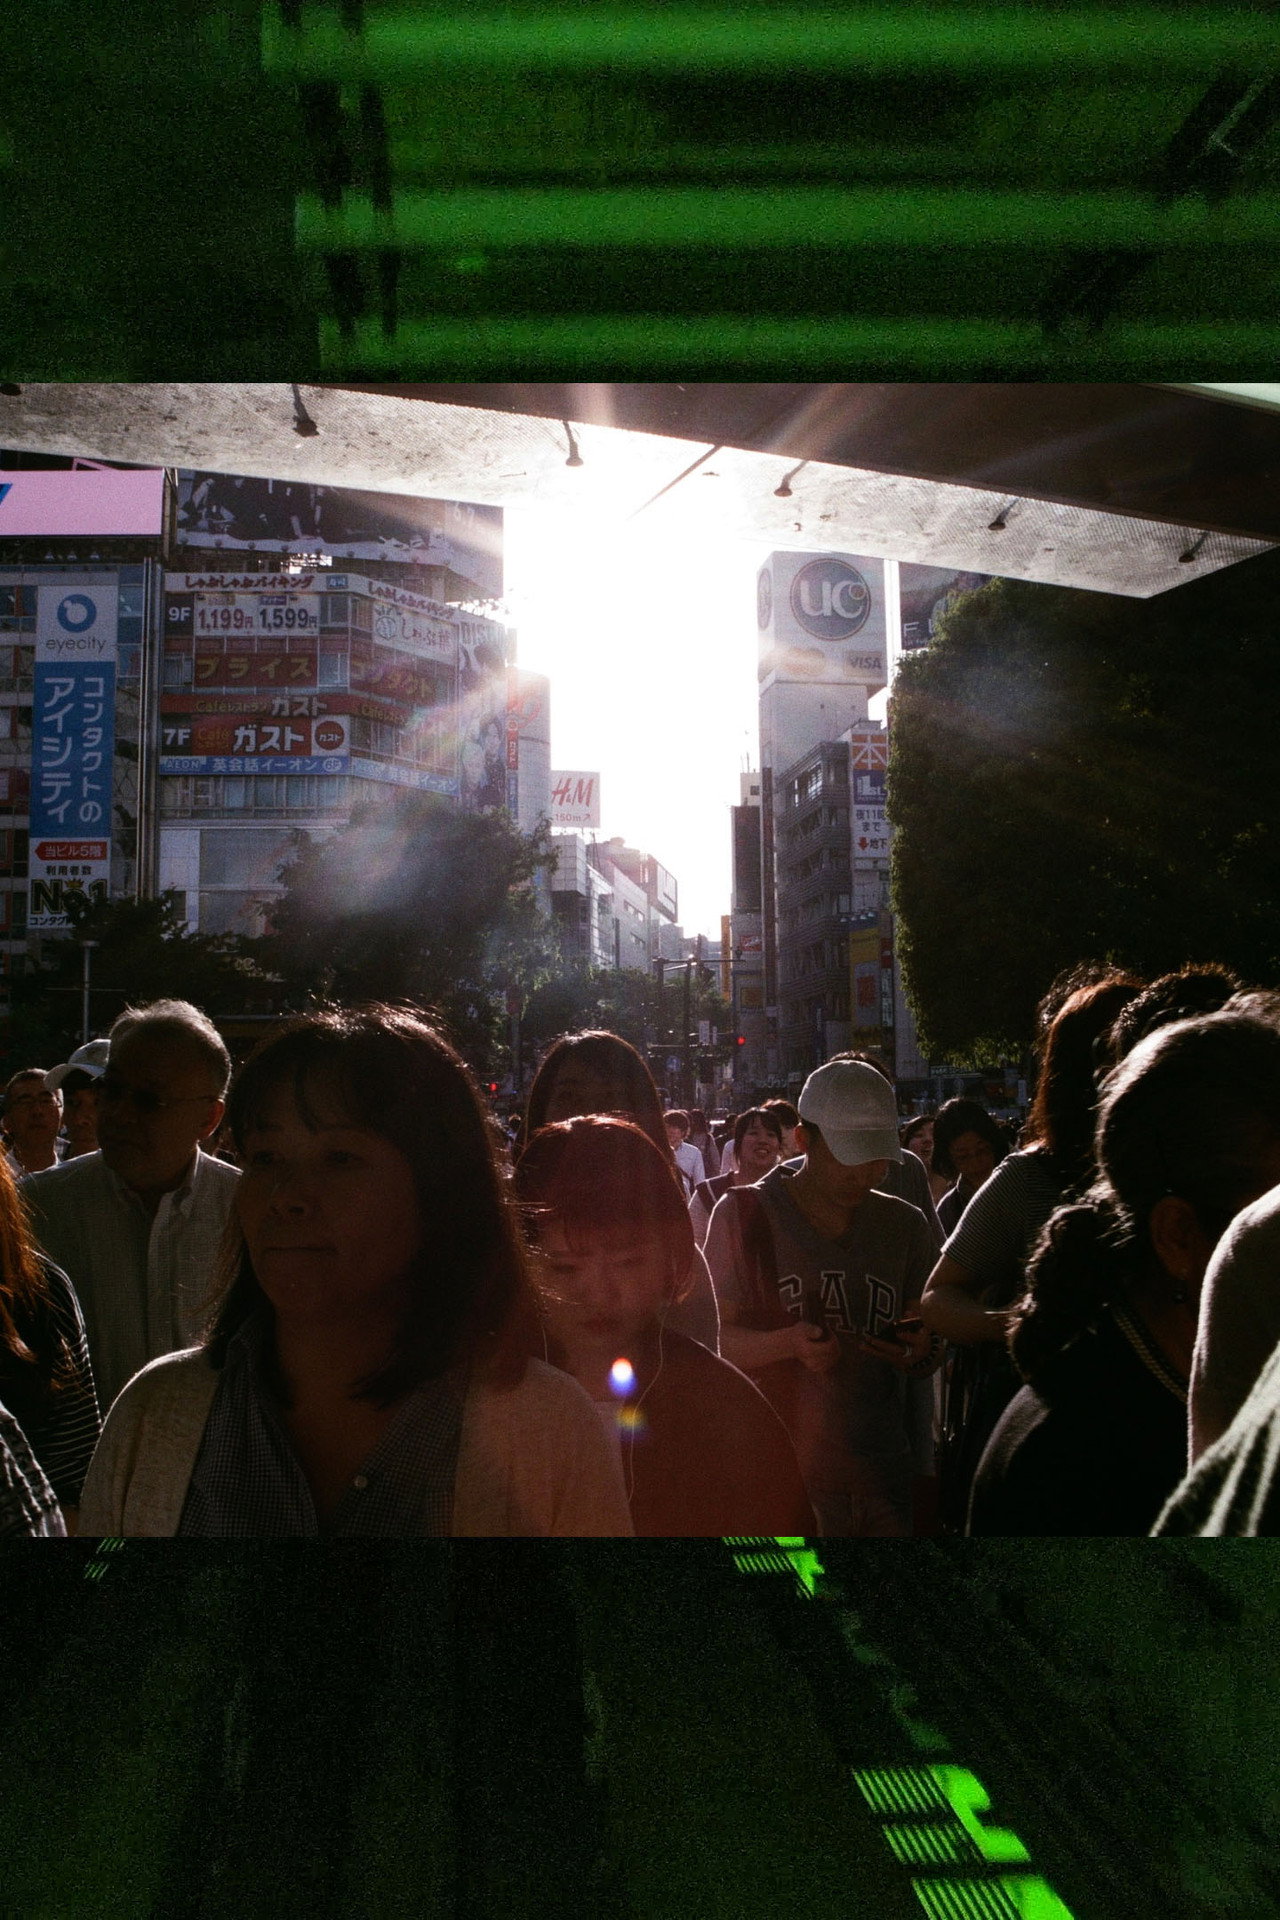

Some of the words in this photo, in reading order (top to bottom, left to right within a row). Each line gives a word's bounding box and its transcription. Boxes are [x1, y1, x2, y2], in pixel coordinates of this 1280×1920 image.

[185, 574, 315, 589] しゃぶしゃぶバイキング
[168, 607, 192, 622] 9F
[198, 608, 254, 632] 1,199円
[259, 608, 318, 632] 1,599円
[46, 637, 107, 654] eyecity
[196, 657, 313, 680] プライス
[850, 657, 882, 670] VISA
[271, 696, 328, 717] ガスト
[164, 728, 192, 746] 7F
[232, 724, 304, 753] ガスト
[319, 733, 342, 742] ガスト
[40, 677, 76, 824] アイシティ
[79, 677, 105, 823] コンタクトの
[852, 734, 889, 770] 本
[166, 758, 201, 770] AEON
[212, 757, 318, 773] 英会話イーオン
[552, 777, 594, 807] H&M
[555, 813, 582, 822] 150m
[862, 821, 881, 832] まで
[45, 844, 103, 858] 当ビル5階
[870, 838, 888, 849] 地下
[46, 865, 92, 876] 利用者数
